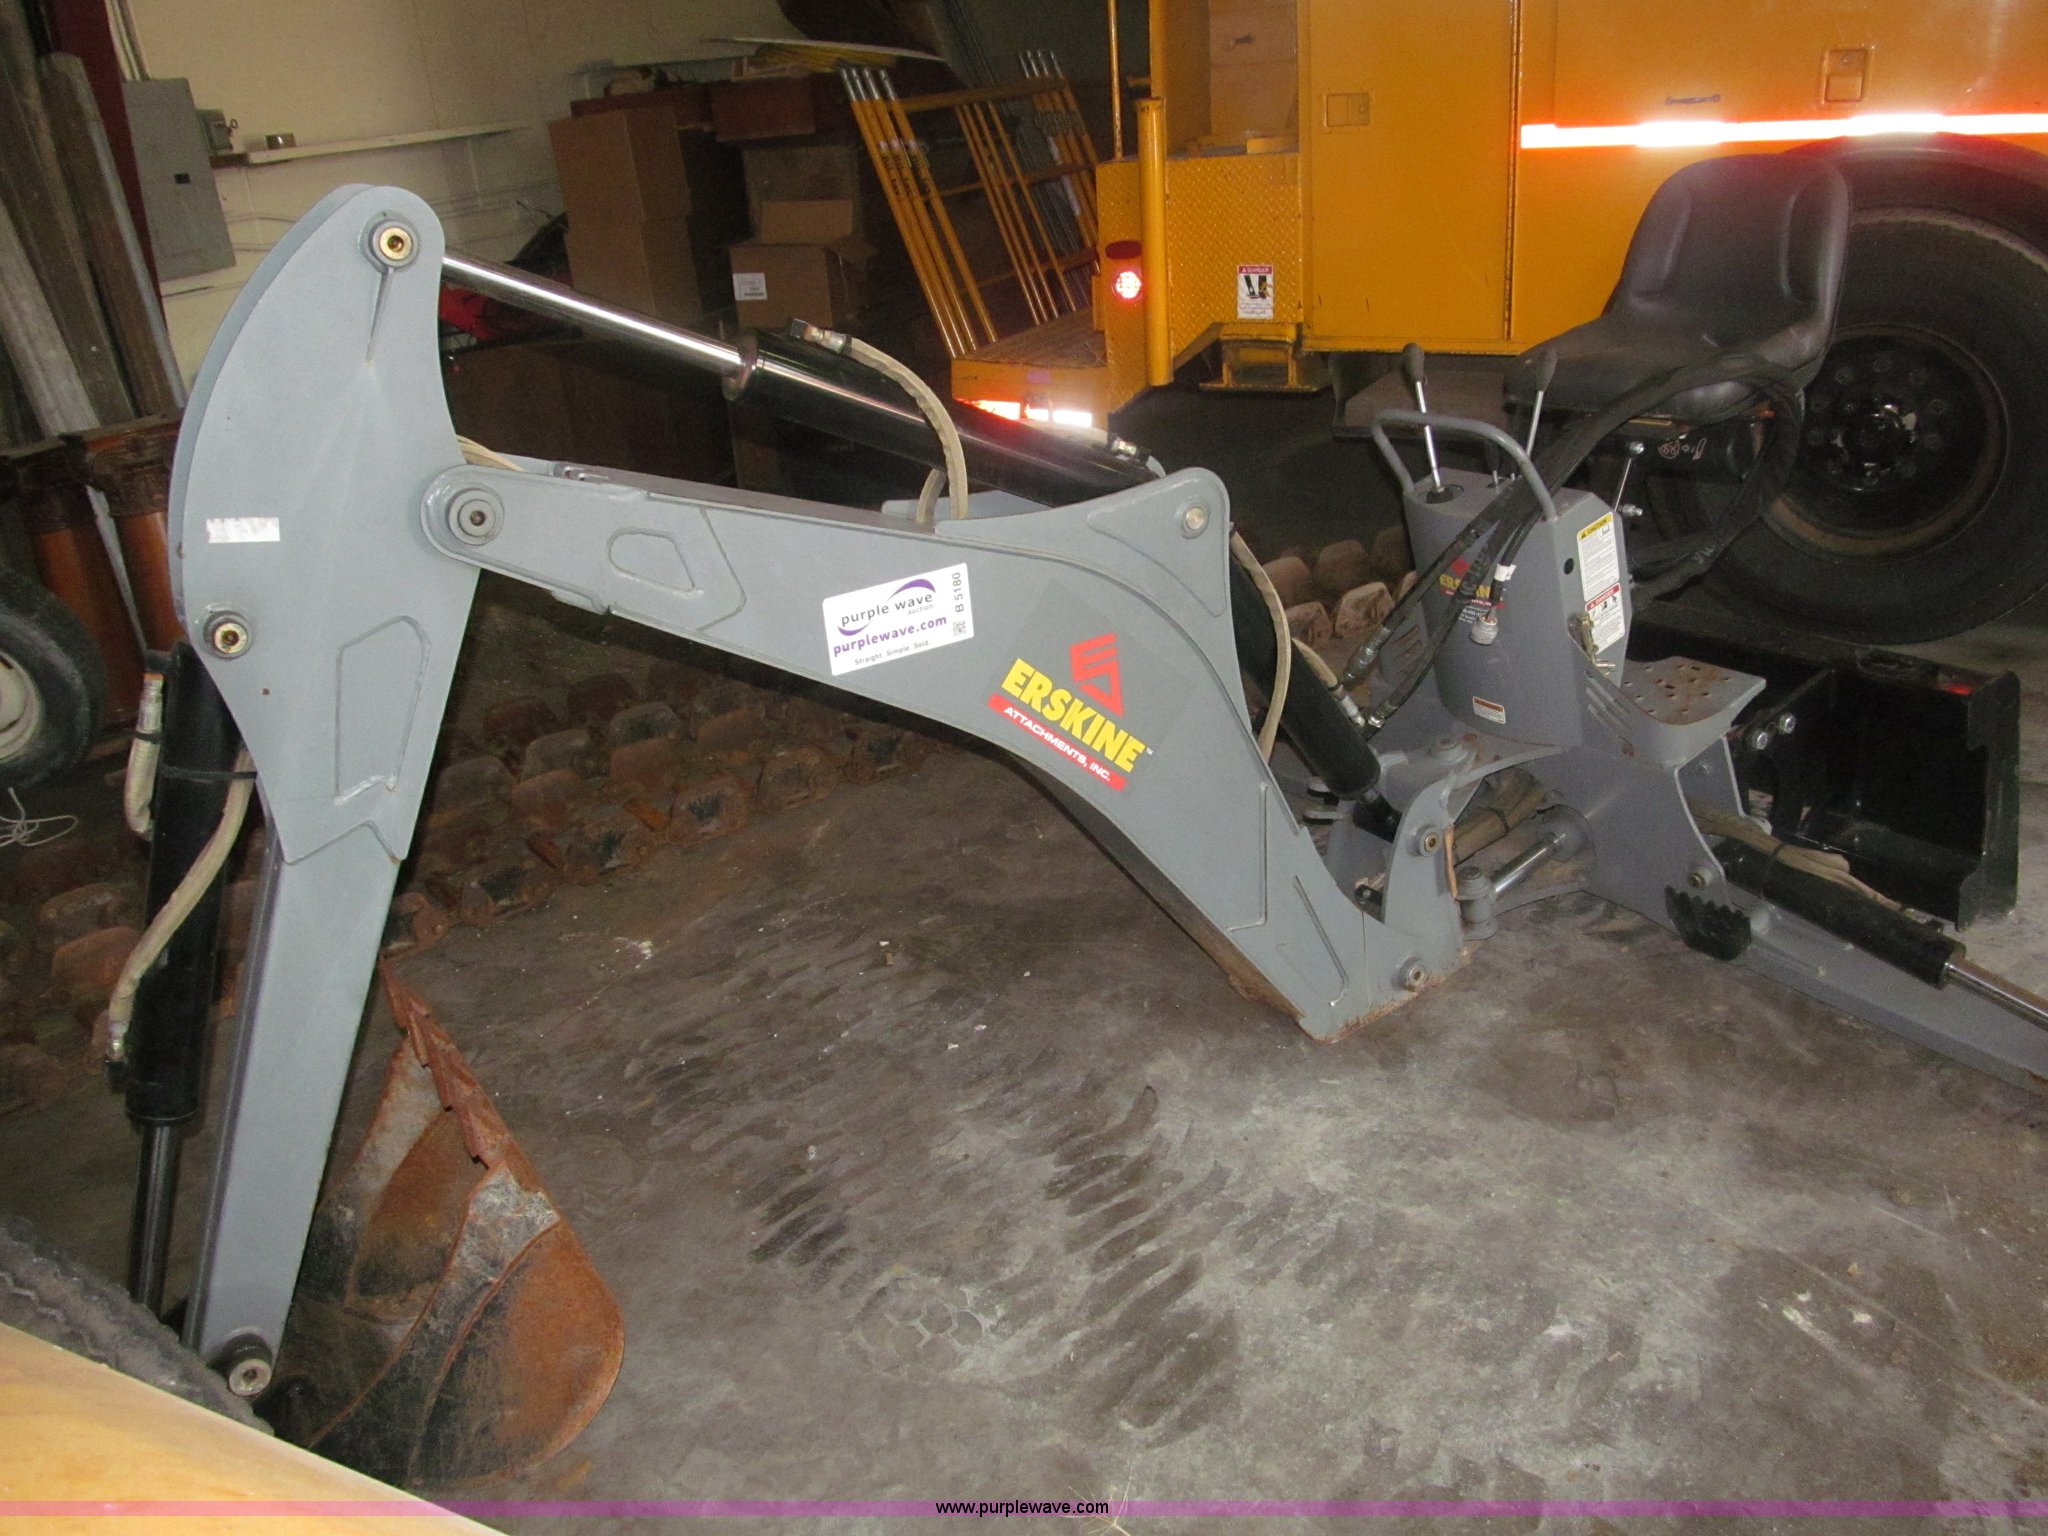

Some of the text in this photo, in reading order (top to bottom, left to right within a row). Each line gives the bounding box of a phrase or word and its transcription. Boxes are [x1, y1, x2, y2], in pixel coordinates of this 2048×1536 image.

[952, 571, 964, 601] 5180
[841, 593, 933, 627] purple wave
[908, 604, 934, 615] auction
[833, 616, 947, 657] purplewave.com
[1001, 658, 1146, 773] ERSKINE
[1004, 707, 1111, 781] ATTACHMENTS, INC.
